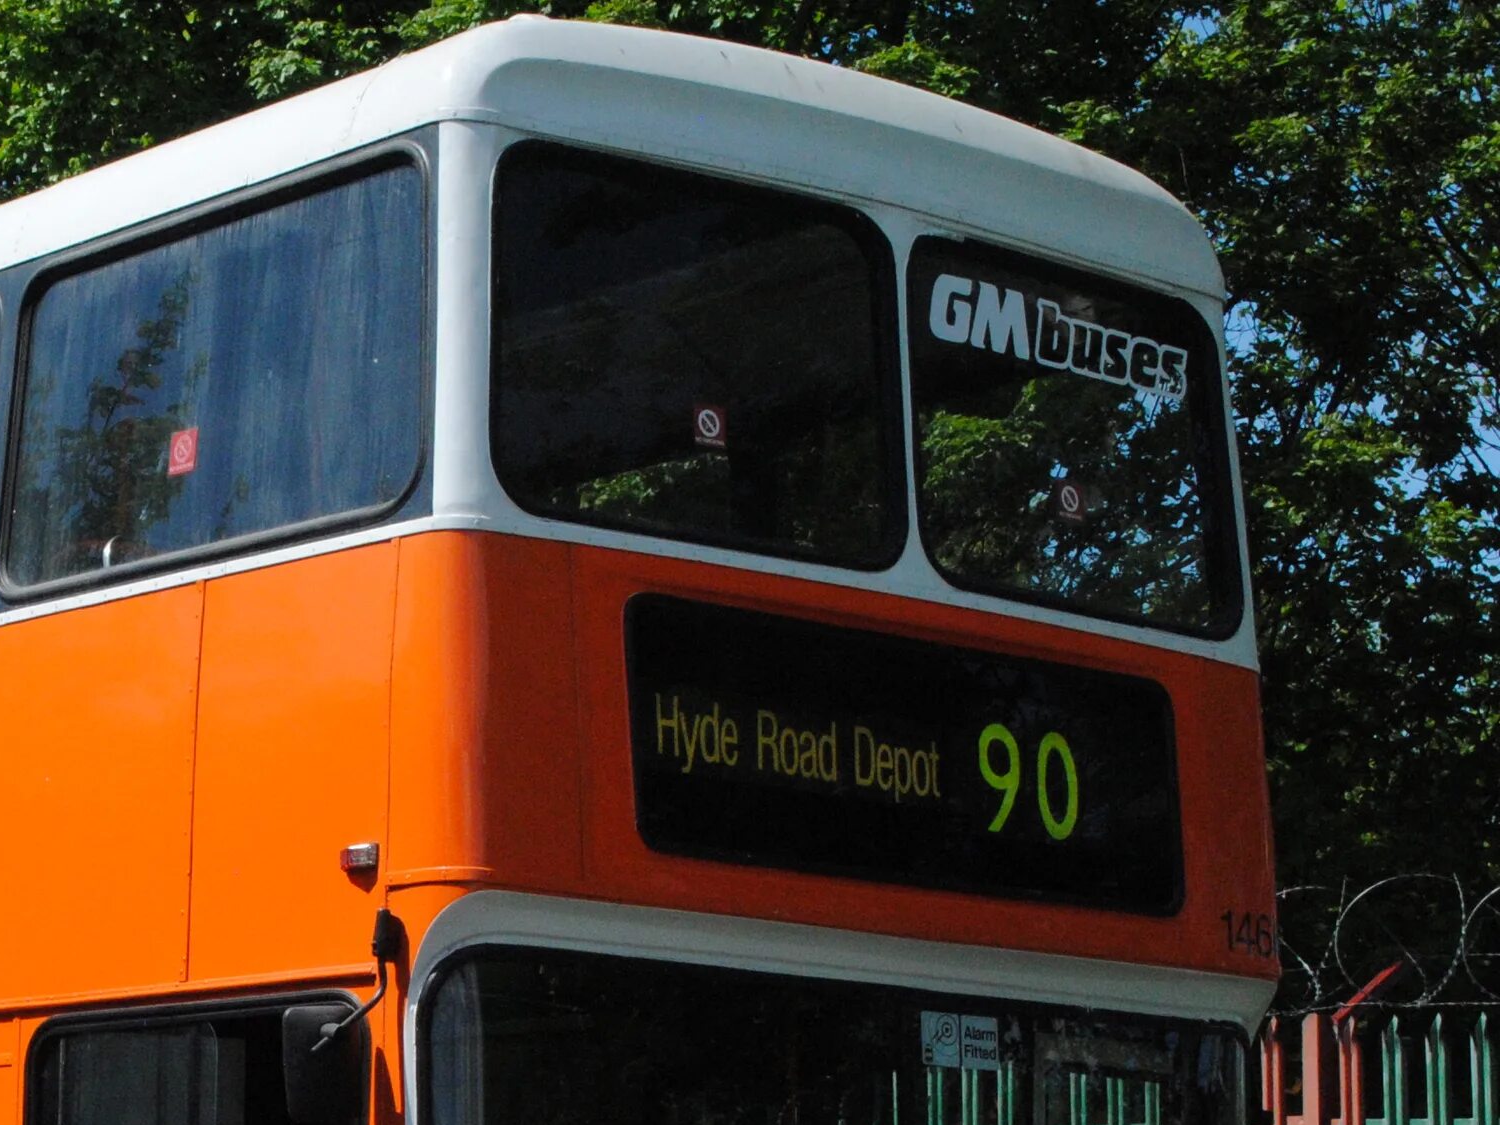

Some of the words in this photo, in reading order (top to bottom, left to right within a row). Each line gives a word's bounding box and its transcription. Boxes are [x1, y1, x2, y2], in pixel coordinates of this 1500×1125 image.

[930, 273, 1030, 360] GM
[1034, 298, 1188, 400] buses
[655, 692, 739, 774] Hyde
[756, 709, 838, 782] Road
[854, 725, 941, 803] Depot
[978, 722, 1079, 841] 90
[1220, 909, 1278, 958] 146
[963, 1043, 998, 1060] Fitted
[964, 1025, 998, 1042] Alarm
